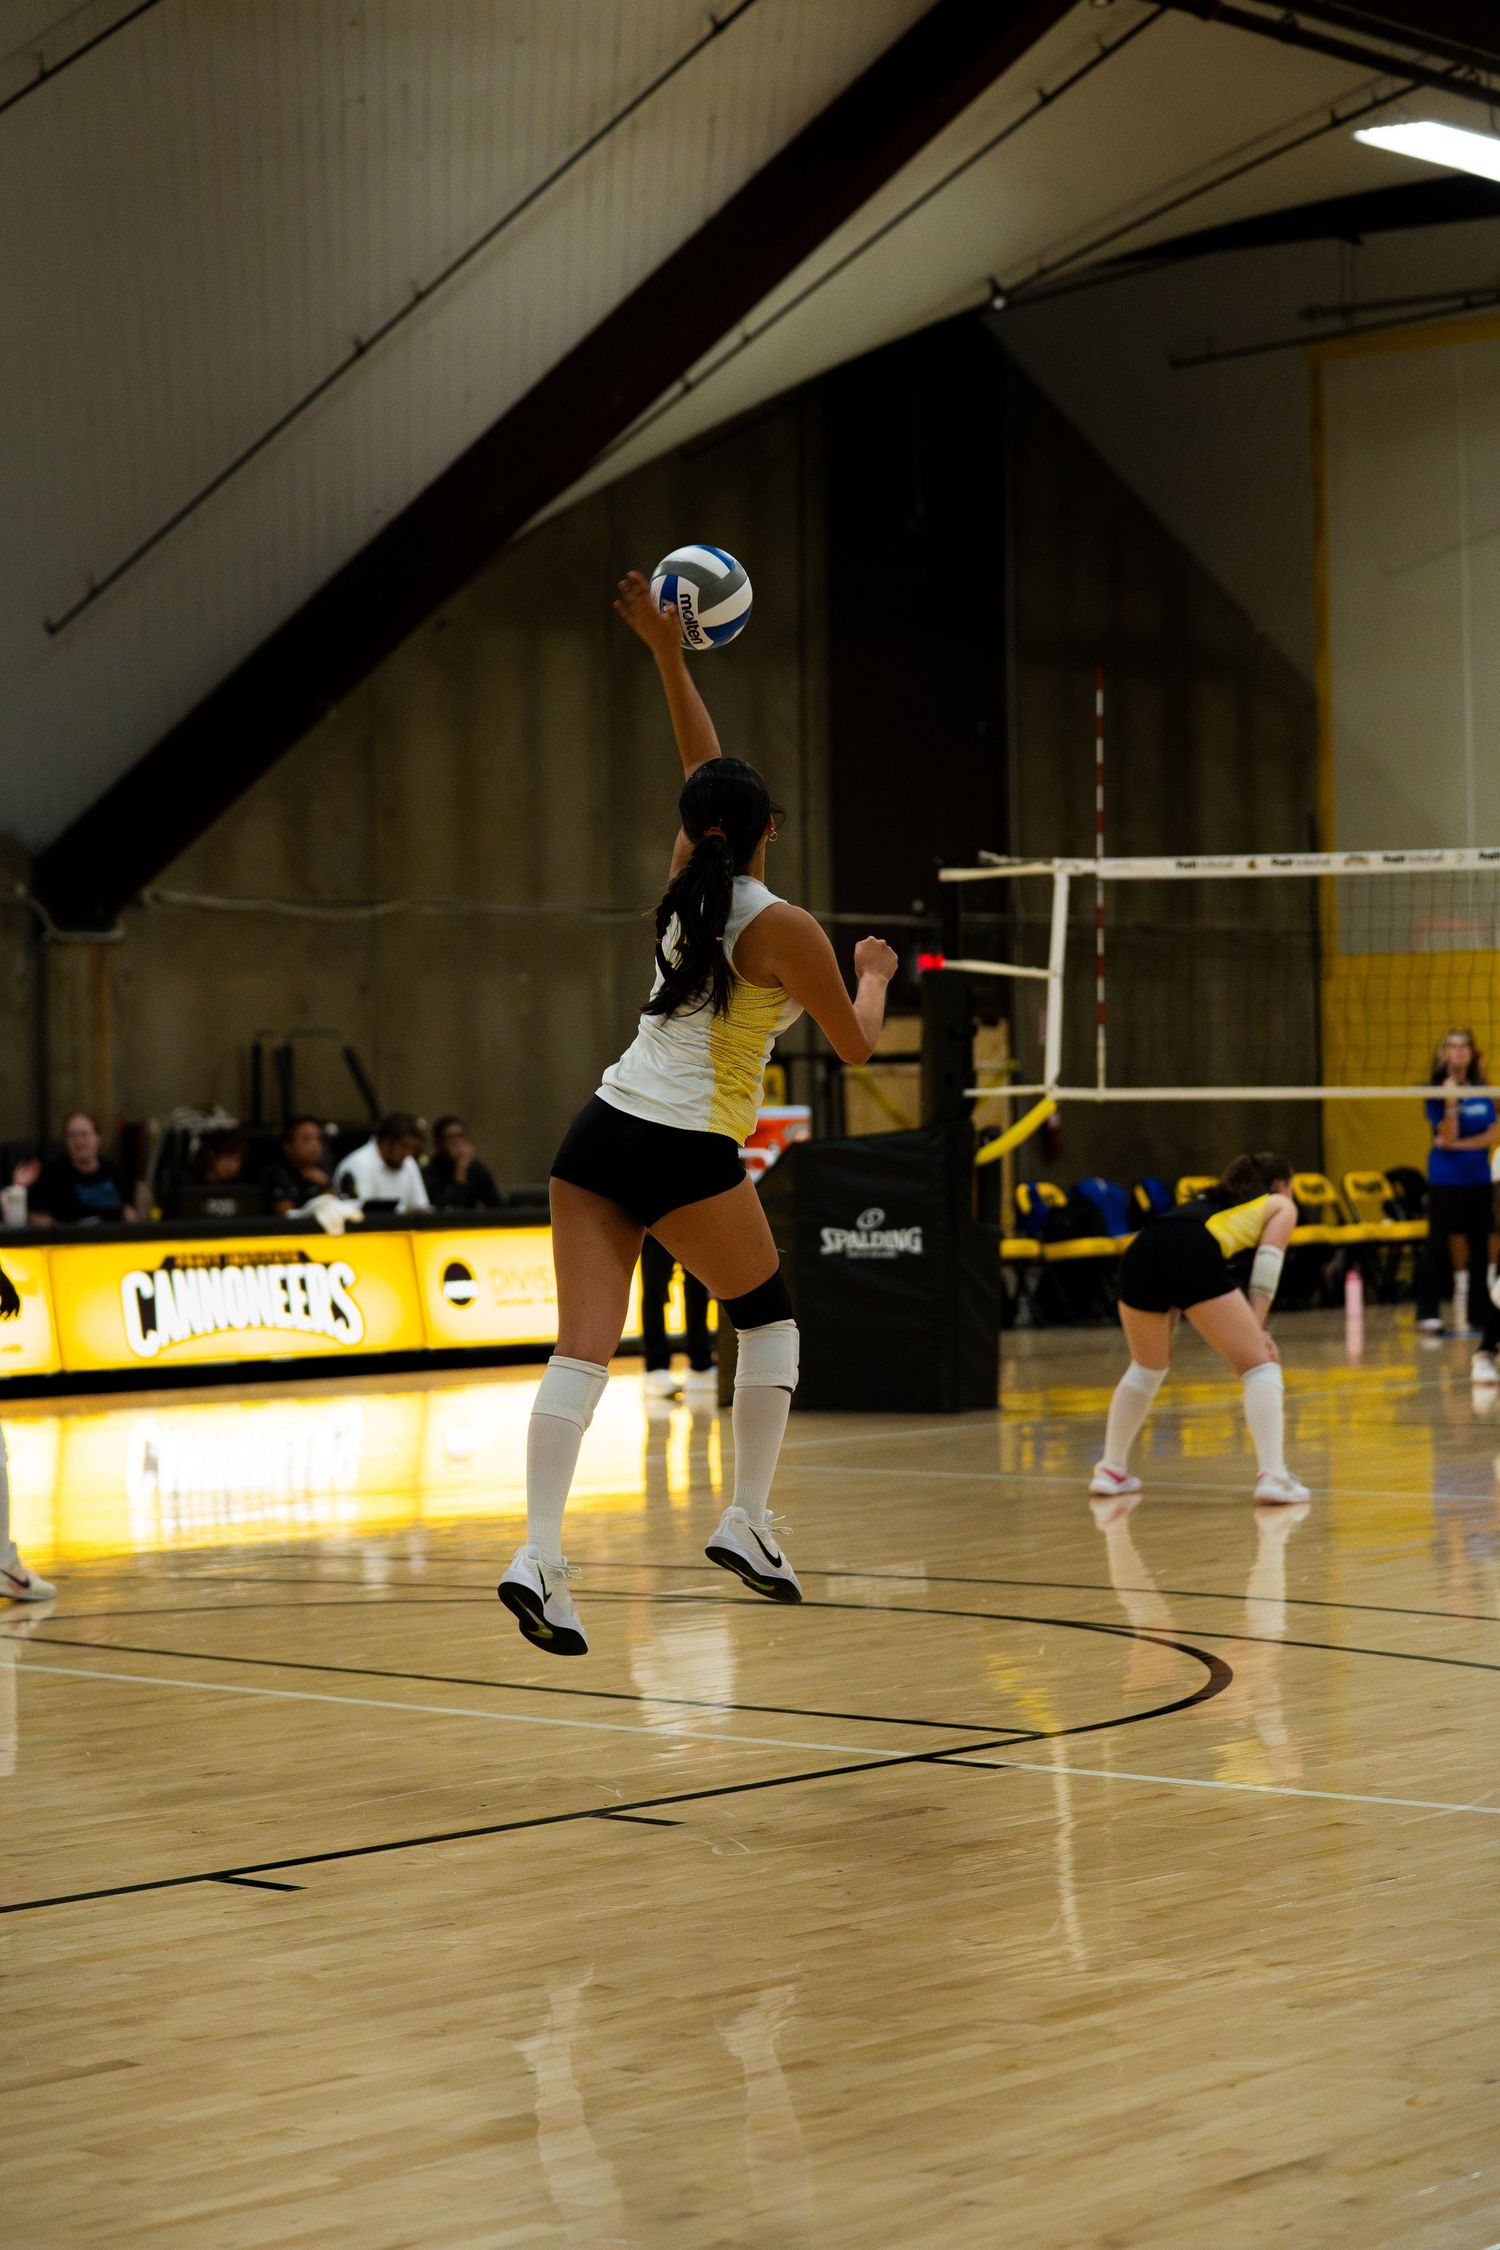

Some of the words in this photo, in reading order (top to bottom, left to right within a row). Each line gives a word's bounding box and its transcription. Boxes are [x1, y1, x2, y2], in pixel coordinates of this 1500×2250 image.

[679, 593, 704, 645] molten
[820, 1226, 922, 1255] SPALDING
[121, 1261, 364, 1358] CANNONEERS
